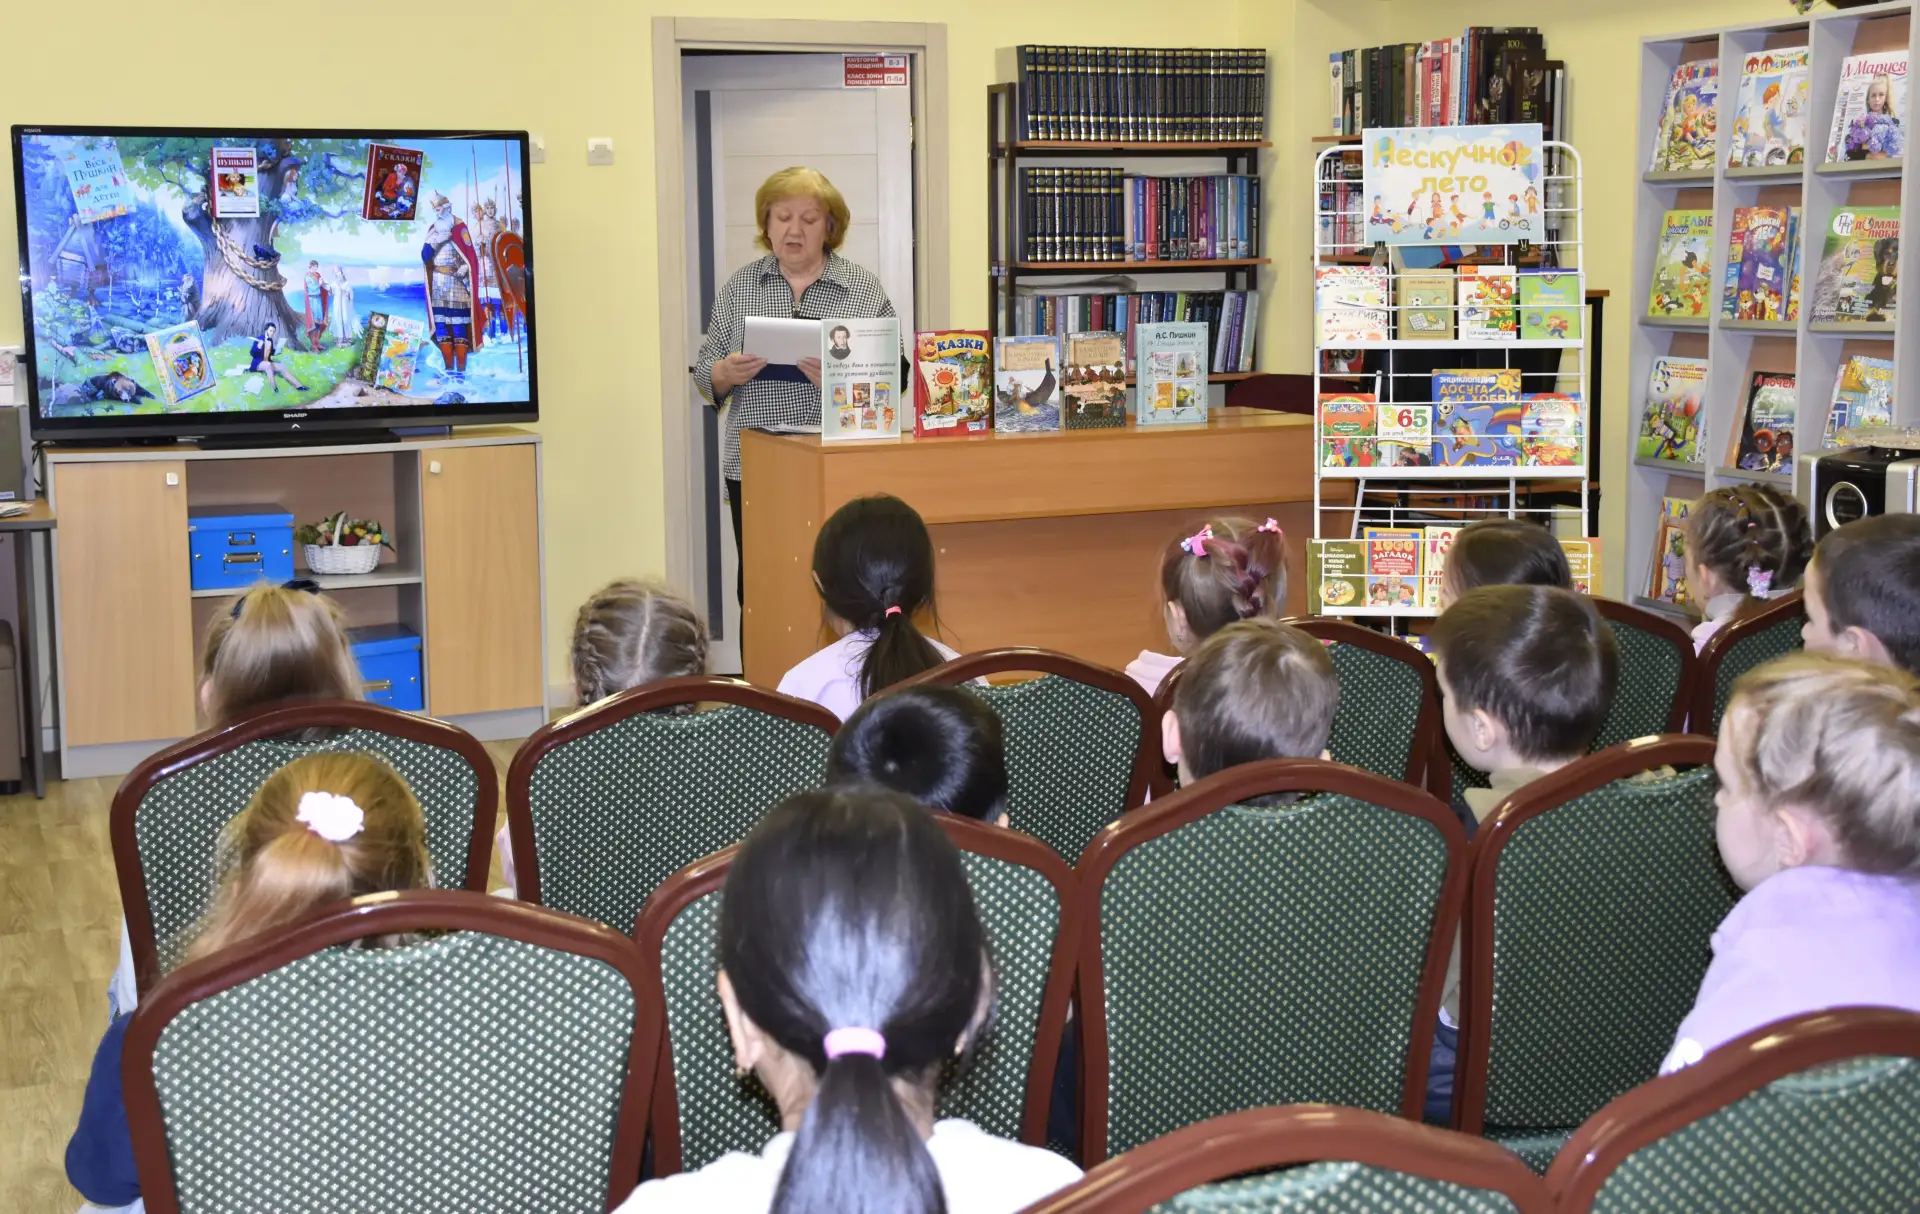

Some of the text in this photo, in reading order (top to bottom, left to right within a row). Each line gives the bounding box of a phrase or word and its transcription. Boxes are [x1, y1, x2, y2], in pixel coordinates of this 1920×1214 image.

[1854, 60, 1907, 78] Маруся
[384, 153, 415, 163] СКАЗКИ
[1373, 143, 1532, 174] Нескучное
[1412, 175, 1488, 195] лето
[1475, 276, 1512, 299] 365
[919, 337, 984, 358] СКАЗКИ
[1439, 376, 1496, 384] ЭНЦИКЛОПЕДИЯ
[1754, 375, 1762, 386] А
[1440, 384, 1489, 394] ДОСУГА
[1472, 394, 1516, 403] ХОББИ
[1383, 407, 1428, 428] 365
[1374, 541, 1415, 552] 1000
[1372, 551, 1414, 561] ЗАГАДОК
